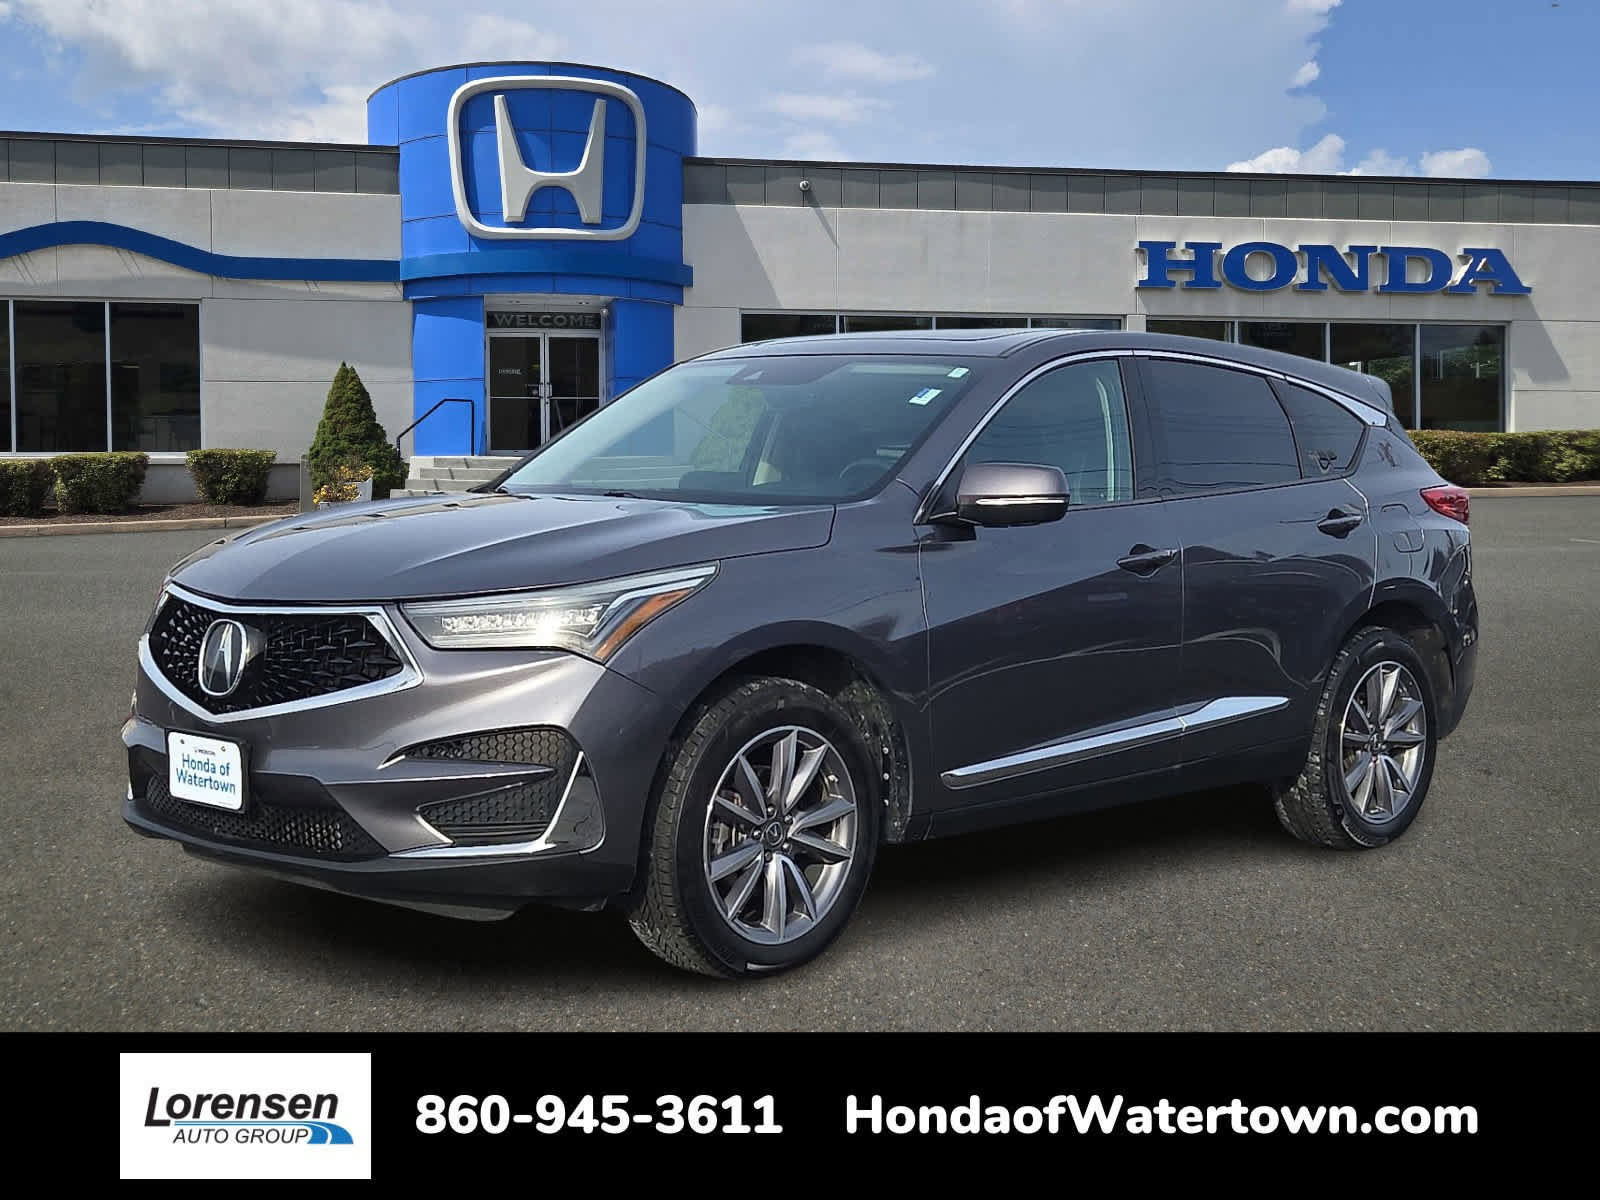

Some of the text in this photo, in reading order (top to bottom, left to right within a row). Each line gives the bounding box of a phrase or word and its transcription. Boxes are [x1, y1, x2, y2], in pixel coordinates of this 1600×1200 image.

[1137, 241, 1532, 295] HONDA
[494, 313, 596, 327] WELCOME
[182, 753, 230, 776] Honda of
[176, 768, 236, 794] Watertown
